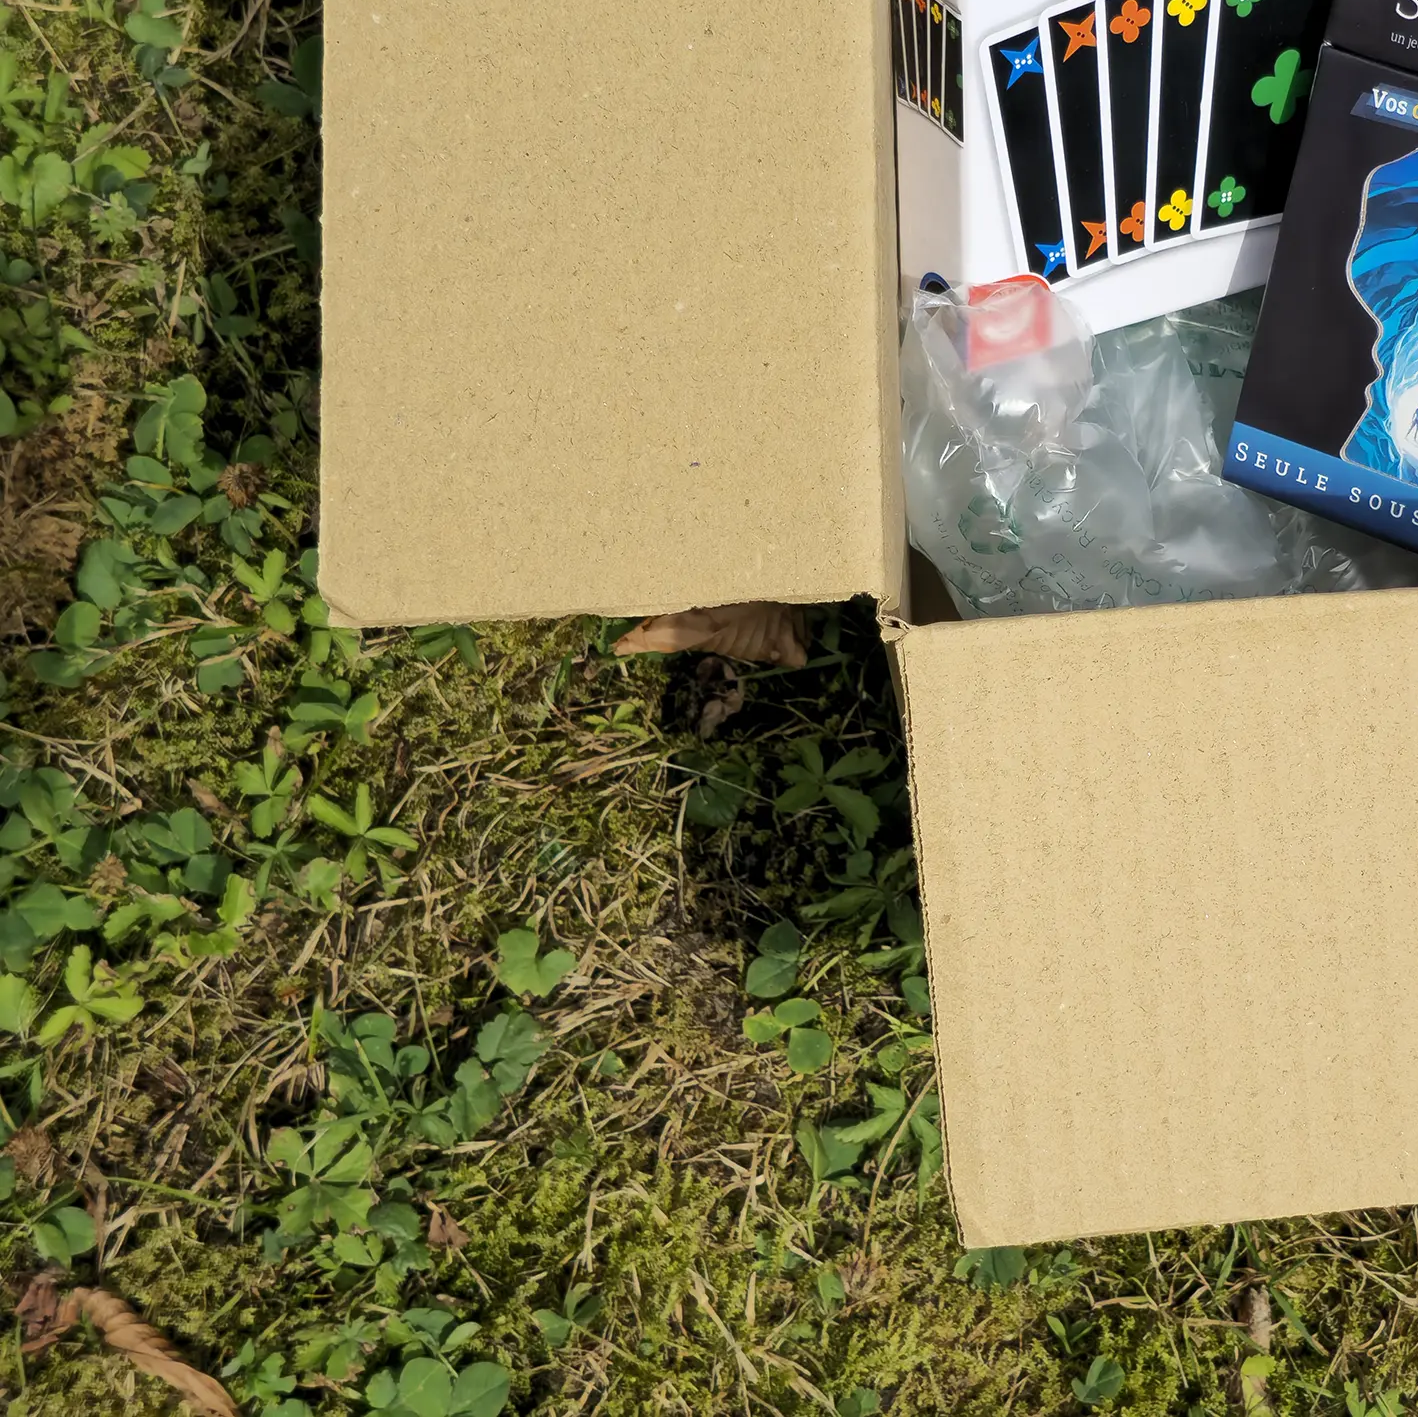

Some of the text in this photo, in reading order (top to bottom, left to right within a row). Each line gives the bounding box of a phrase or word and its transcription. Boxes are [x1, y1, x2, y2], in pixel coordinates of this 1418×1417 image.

[1389, 32, 1405, 46] un
[1371, 87, 1407, 116] Vos
[1234, 441, 1330, 492] SEULE
